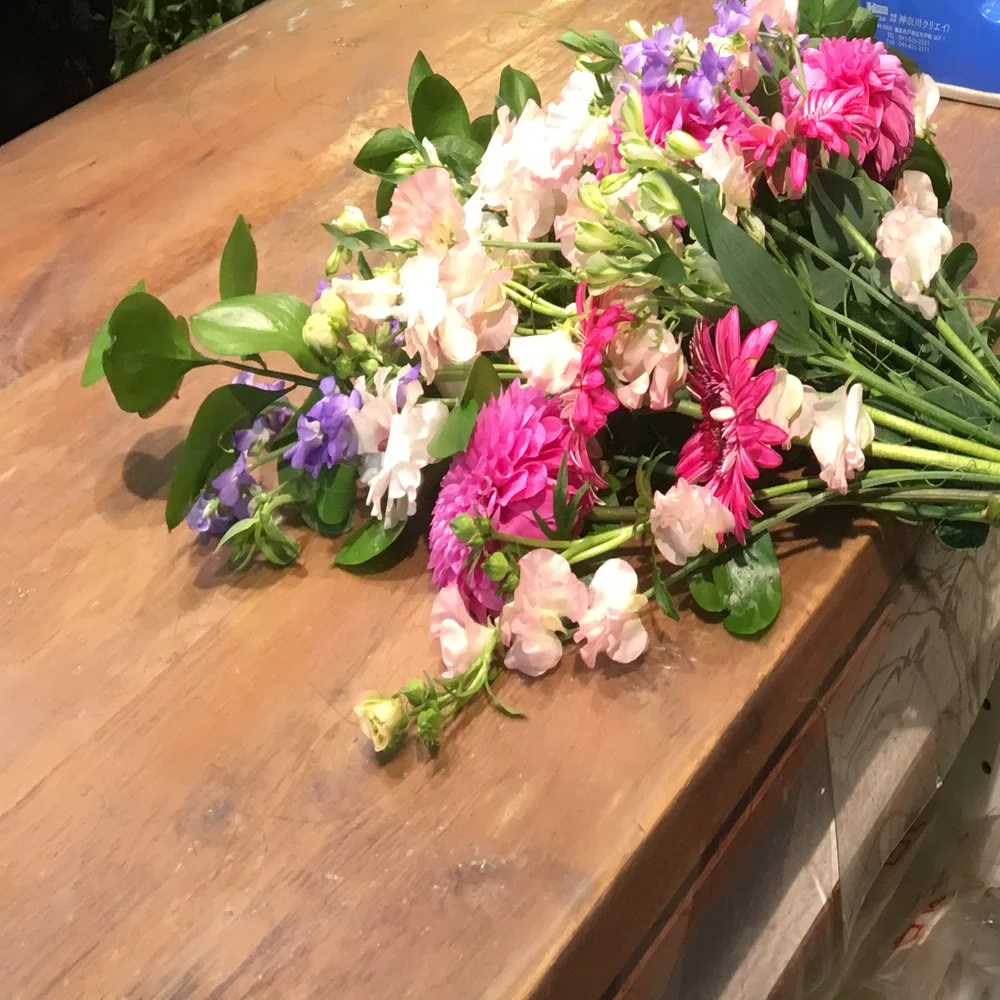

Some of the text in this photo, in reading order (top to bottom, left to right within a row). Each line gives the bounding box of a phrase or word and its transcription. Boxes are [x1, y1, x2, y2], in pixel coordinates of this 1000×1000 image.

[899, 14, 952, 33] 神奈川クリエイト
